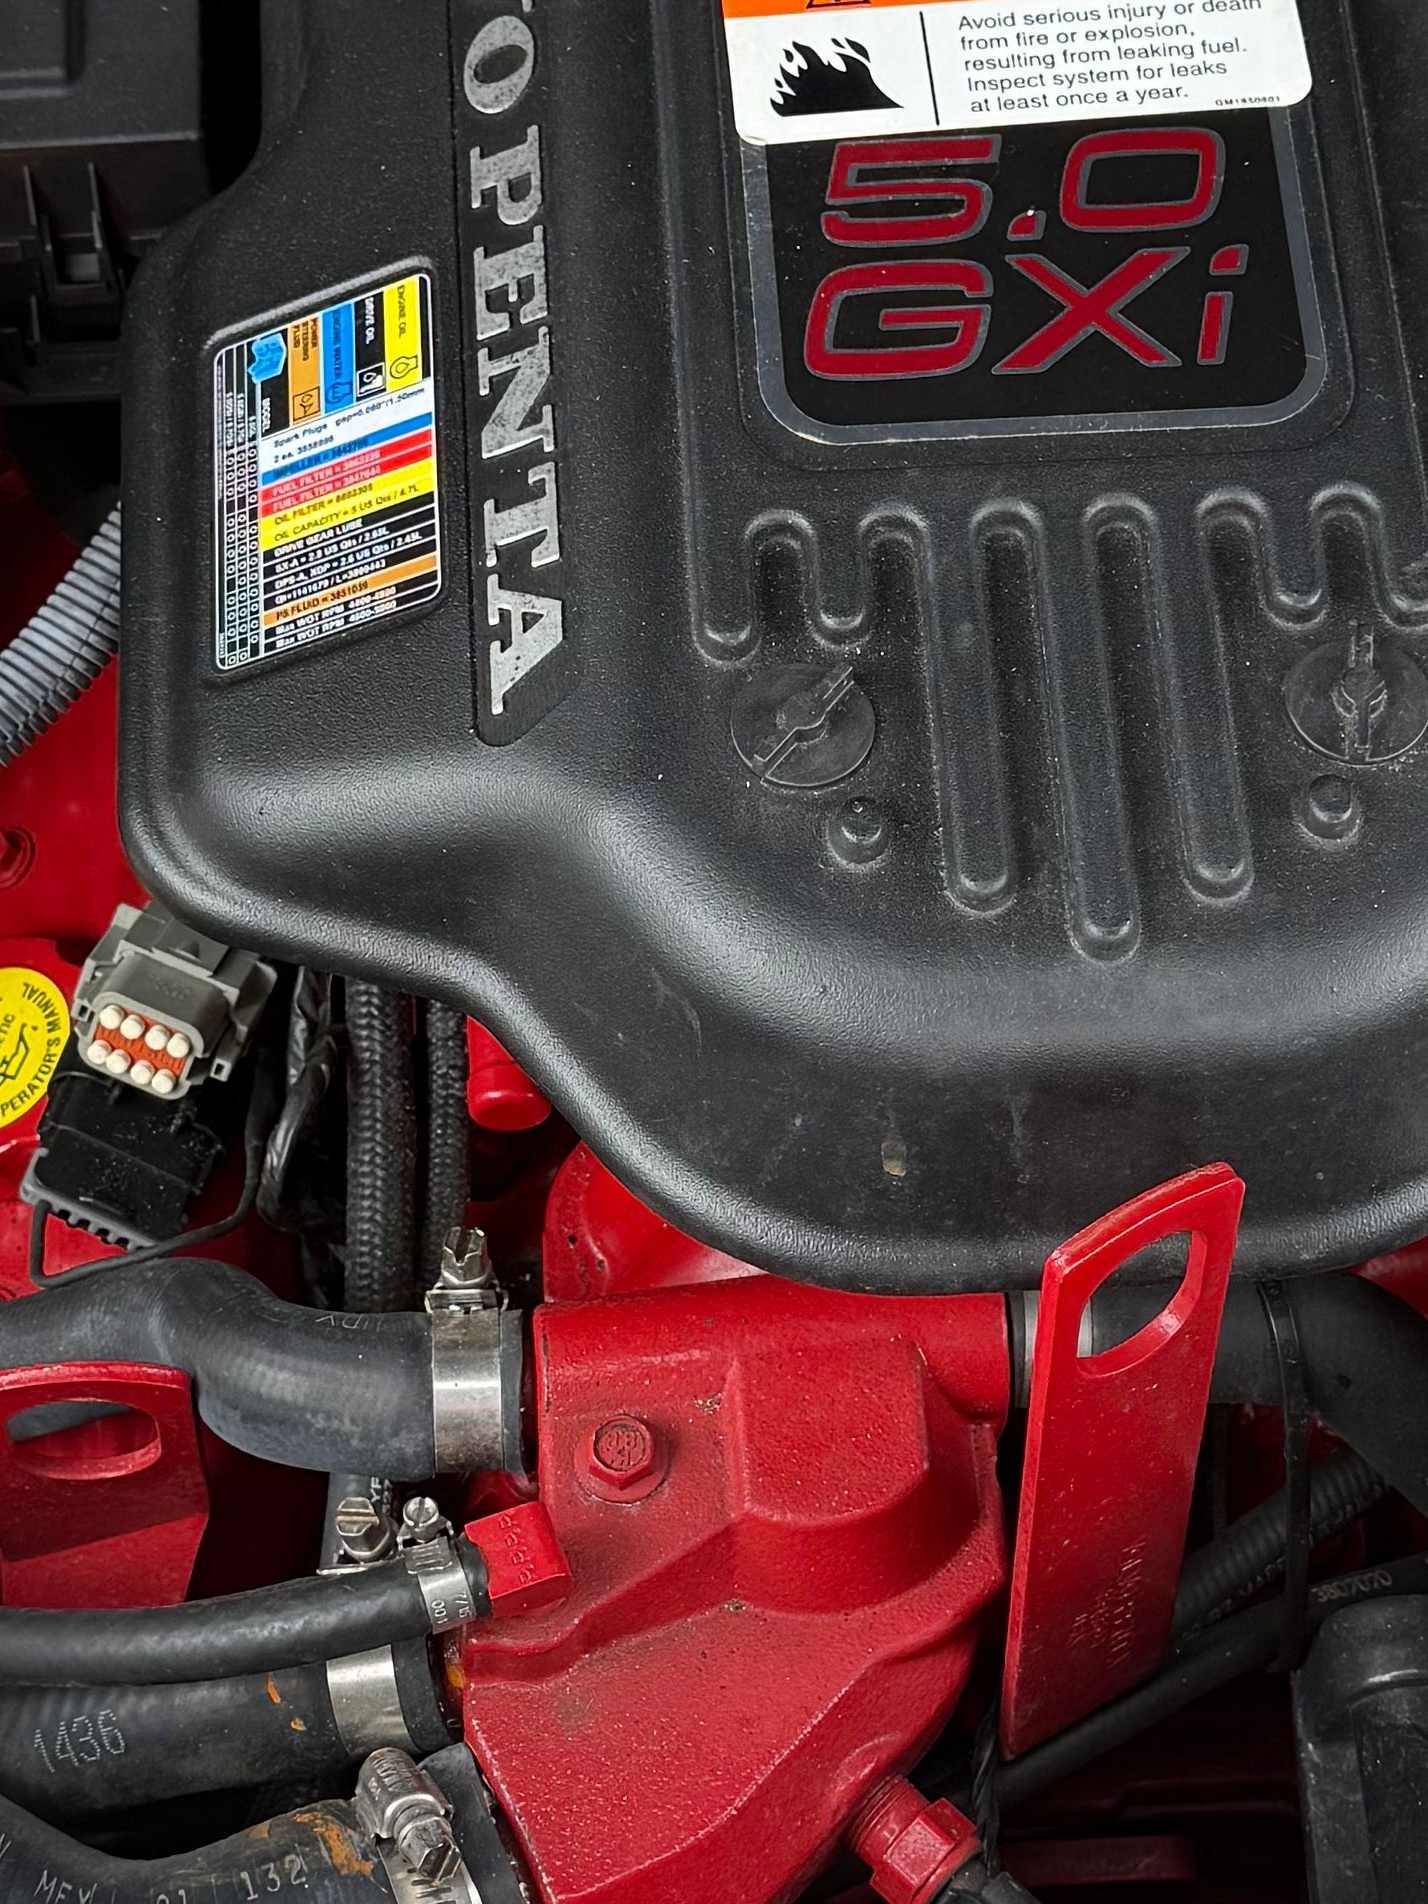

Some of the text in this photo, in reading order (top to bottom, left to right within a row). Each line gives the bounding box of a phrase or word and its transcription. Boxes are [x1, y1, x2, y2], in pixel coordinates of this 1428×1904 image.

[958, 14, 1017, 32] Avoid
[1023, 7, 1102, 27] serious
[1107, 3, 1166, 23] injury
[1173, 1, 1196, 15] or
[960, 22, 1195, 51] from fire or explosion,
[964, 37, 1248, 72] resulting from leaking fuel.
[967, 60, 1228, 93] Inspect system for leaks
[970, 85, 1189, 113] at least once a year.
[820, 125, 1227, 249] 5.0
[803, 243, 1249, 380] GXi
[469, 123, 566, 717] PENTA
[292, 511, 339, 536] CAPACITY
[22, 982, 61, 1033] MANUAL
